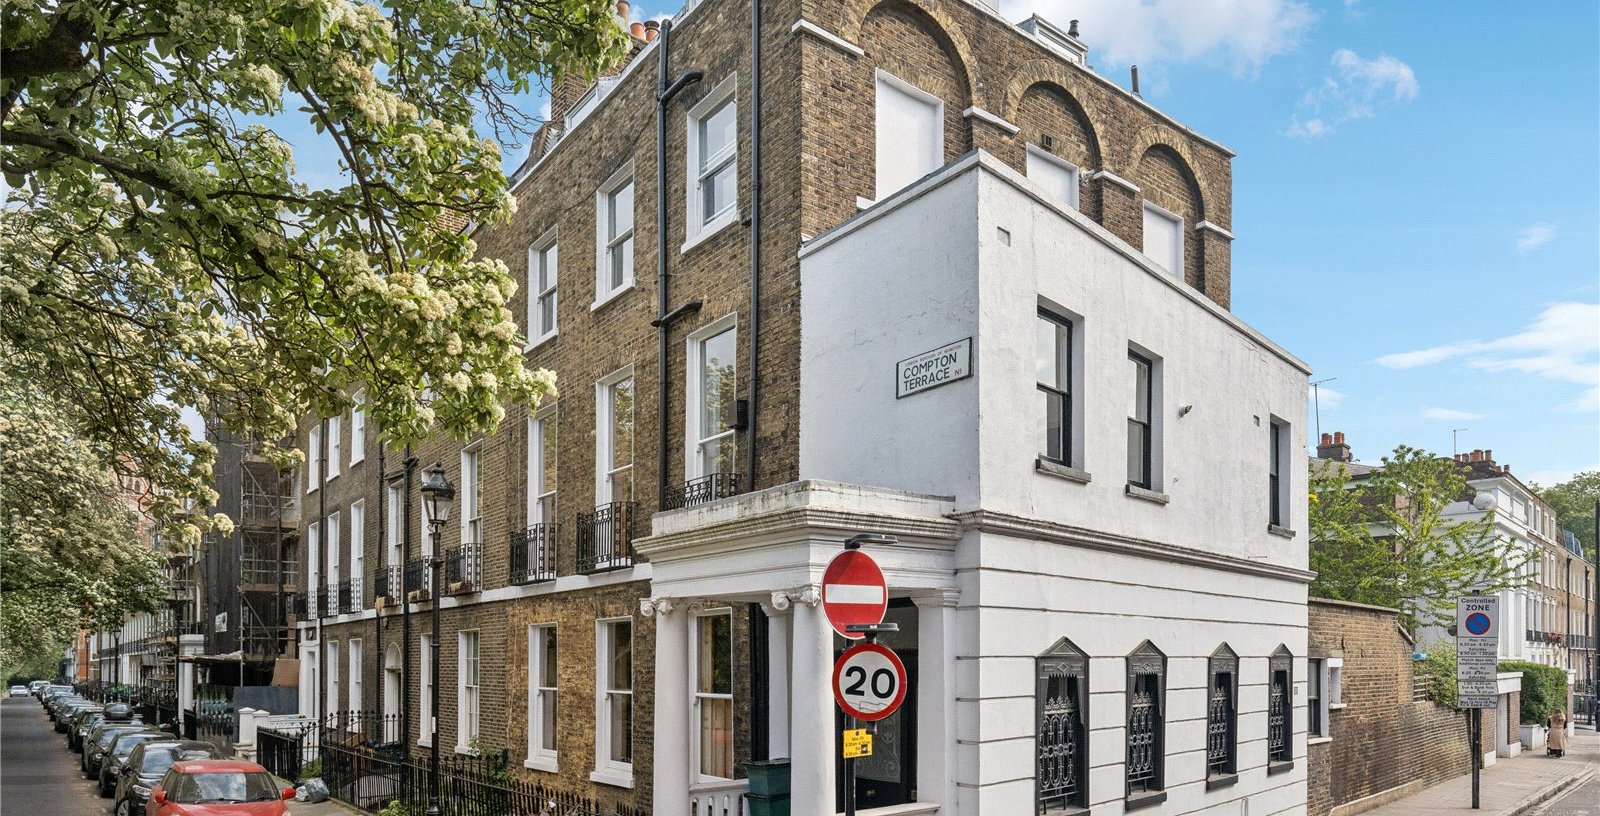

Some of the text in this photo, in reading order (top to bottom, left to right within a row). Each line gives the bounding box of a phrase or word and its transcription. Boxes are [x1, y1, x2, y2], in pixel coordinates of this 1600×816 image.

[903, 352, 957, 379] COMPTON
[903, 367, 962, 391] TERRACE N1
[845, 665, 896, 699] 20
